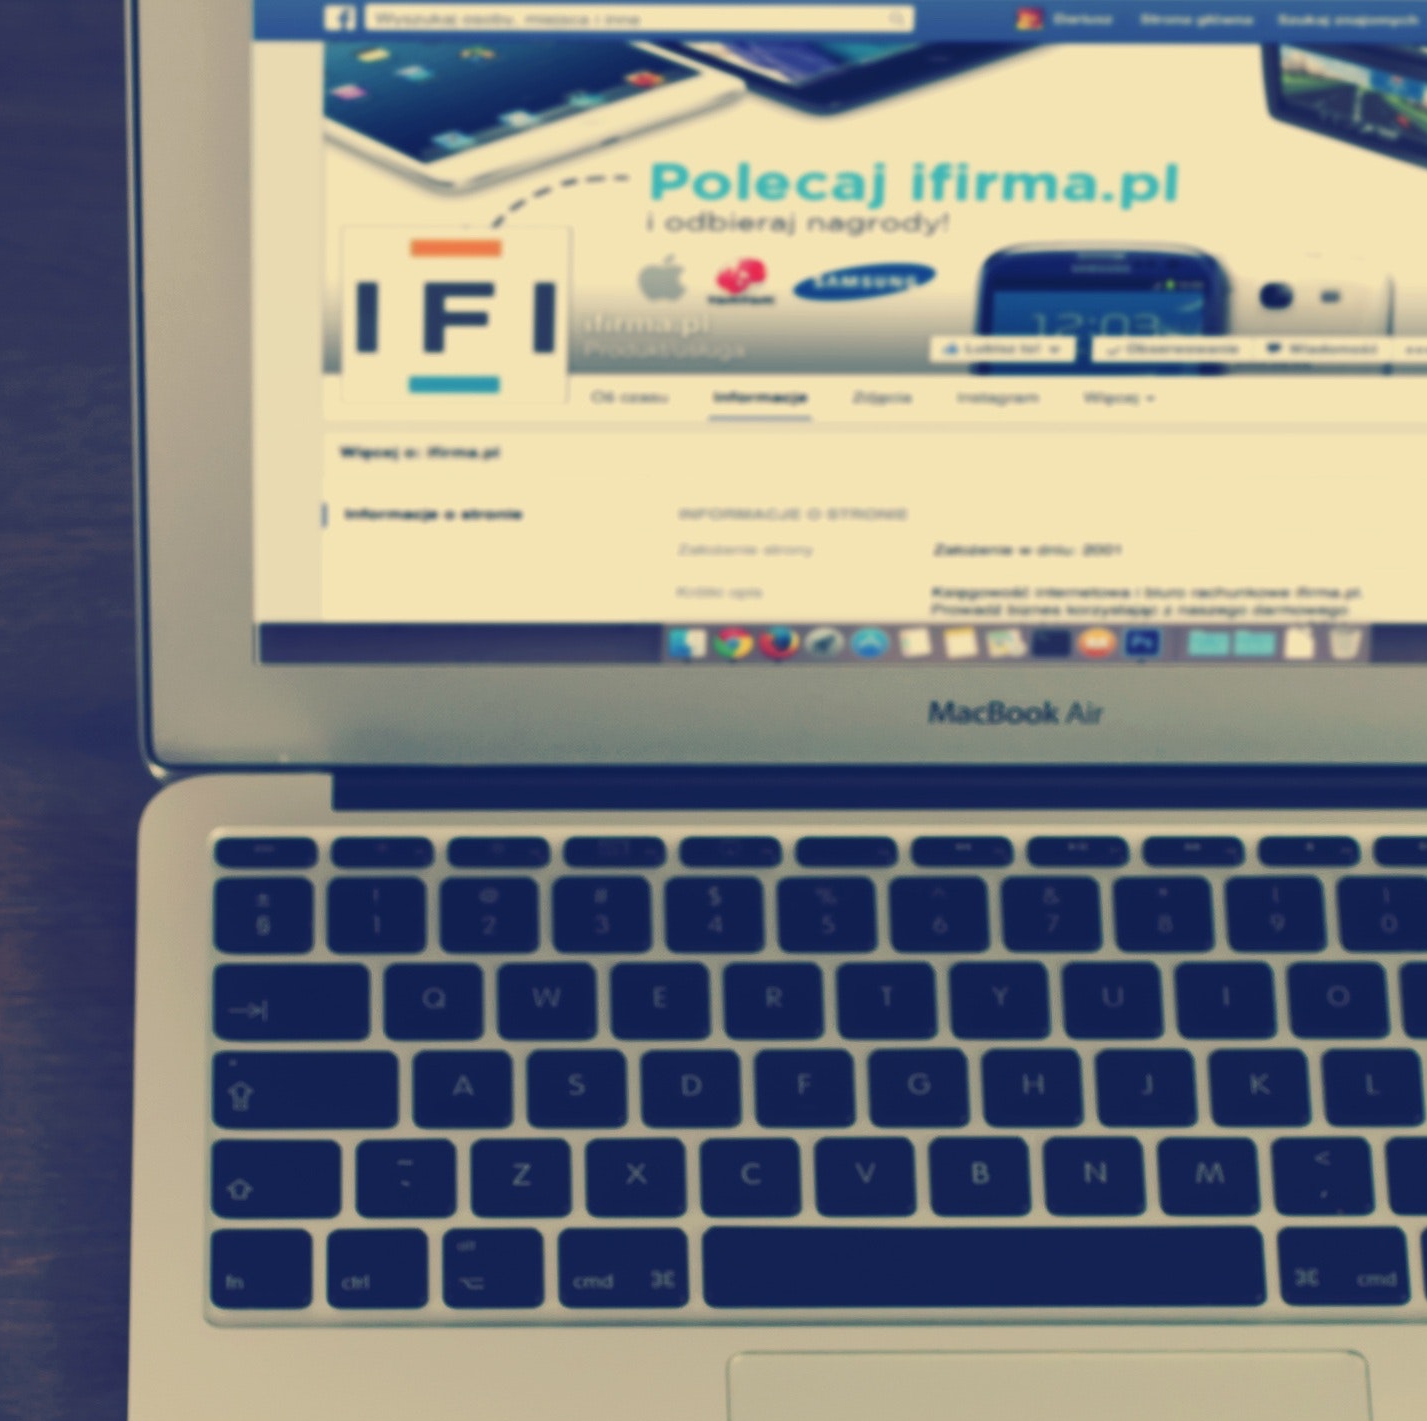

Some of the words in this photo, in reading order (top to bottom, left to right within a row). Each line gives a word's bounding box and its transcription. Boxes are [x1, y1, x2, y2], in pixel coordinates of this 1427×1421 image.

[1140, 12, 1193, 26] Strona
[1278, 12, 1330, 29] Szukaj
[650, 161, 886, 210] Polecaj
[910, 161, 1179, 210] ifirma.pl
[646, 211, 655, 232] i
[663, 211, 797, 237] odbieraj
[807, 211, 950, 237] nagrody!
[813, 273, 921, 291] SAMSUNG
[712, 390, 809, 407] Informacje
[852, 390, 912, 407] Zdjęcia
[957, 390, 1040, 407] Instagram
[1083, 390, 1140, 407] Więcej
[339, 445, 400, 462] Więcej
[426, 446, 501, 462] ifirma.pl
[343, 507, 439, 524] Informacje
[460, 507, 523, 522] stronie
[678, 506, 802, 522] INFORMACJE
[806, 506, 822, 522] O
[827, 506, 908, 522] STRONIE
[762, 542, 814, 560] strony
[1082, 542, 1123, 557] 2001
[1034, 584, 1131, 600] internetowa
[1145, 584, 1186, 600] biuro
[1006, 602, 1061, 617] biznes
[1177, 604, 1247, 620] naszego
[1131, 635, 1155, 651] Ps
[928, 700, 1059, 726] MacBook
[1065, 700, 1106, 726] Air
[482, 915, 497, 935] 2
[596, 914, 610, 934] 3
[708, 915, 723, 932] 4
[822, 915, 836, 934] 5
[932, 916, 948, 934] 6
[1048, 914, 1059, 933] 7
[1158, 914, 1173, 933] 8
[1269, 913, 1285, 931] 9
[422, 987, 446, 1009] Q
[532, 988, 561, 1007] W
[653, 986, 665, 1008] E
[766, 986, 782, 1006] R
[881, 986, 892, 1006] T
[992, 987, 1008, 1005] Y
[1102, 987, 1124, 1007] U
[1326, 985, 1350, 1007] O
[453, 1075, 474, 1095] A
[568, 1074, 585, 1096] S
[681, 1074, 702, 1096] D
[798, 1073, 810, 1094] F
[908, 1073, 931, 1095] G
[1023, 1074, 1044, 1094] H
[1143, 1074, 1153, 1095] J
[1250, 1074, 1270, 1094] K
[1366, 1074, 1379, 1095] L
[513, 1163, 531, 1186] Z
[627, 1163, 646, 1184] X
[741, 1163, 761, 1185] C
[856, 1163, 875, 1183] V
[972, 1162, 989, 1184] B
[1084, 1162, 1107, 1182] N
[1196, 1162, 1224, 1183] M
[226, 1274, 244, 1289] fn
[342, 1275, 370, 1290] ctrl
[573, 1274, 614, 1289] cmd
[1357, 1272, 1397, 1287] cmd
